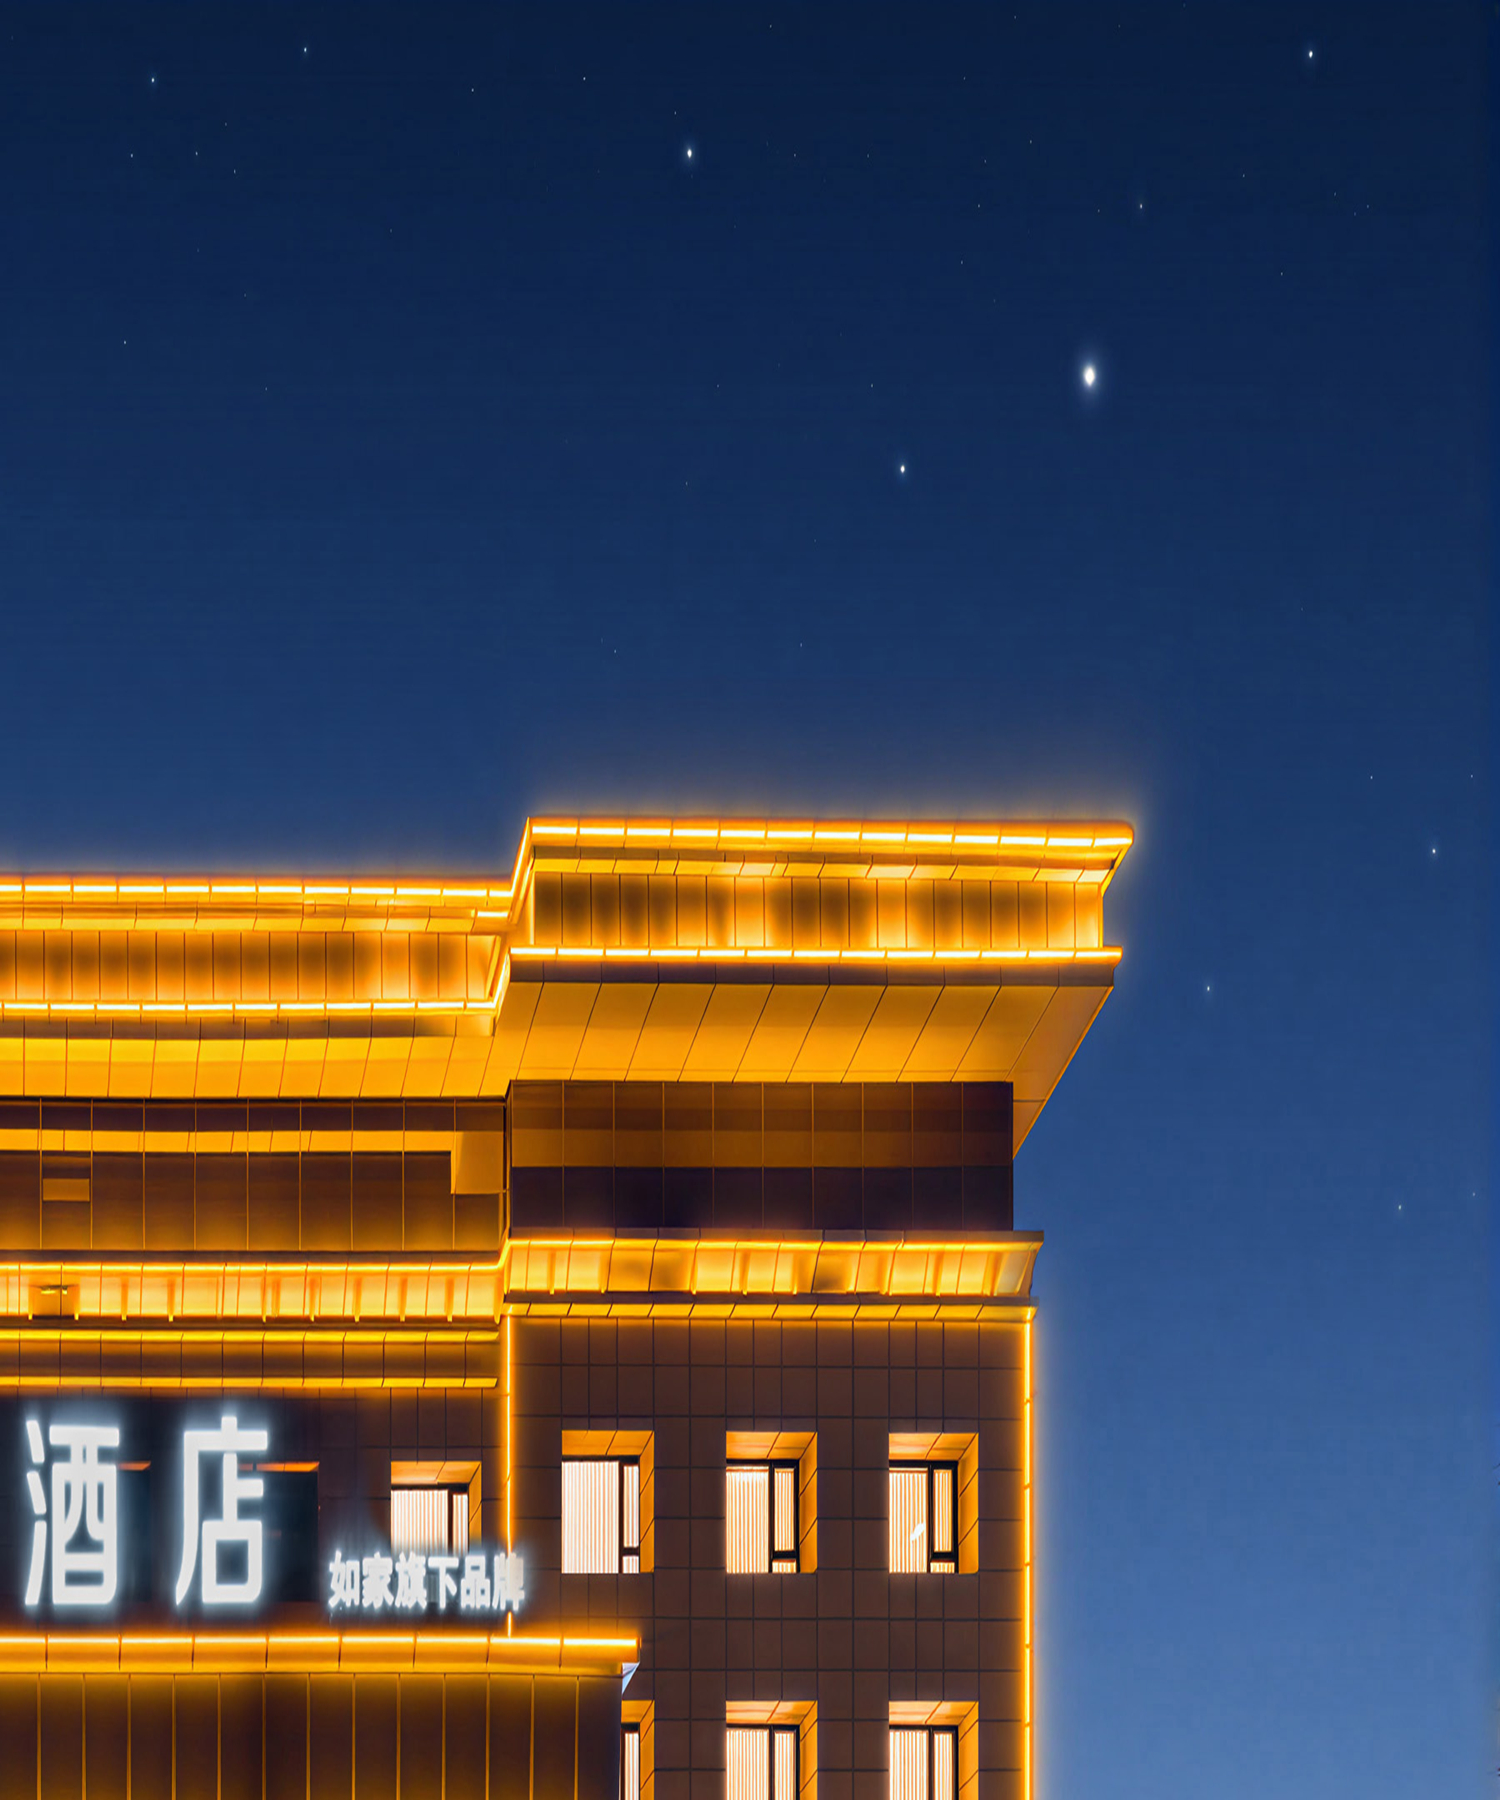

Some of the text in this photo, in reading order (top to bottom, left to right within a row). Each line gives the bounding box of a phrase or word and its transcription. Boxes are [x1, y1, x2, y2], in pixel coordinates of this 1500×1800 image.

[328, 1549, 525, 1612] 如家旗下品牌
